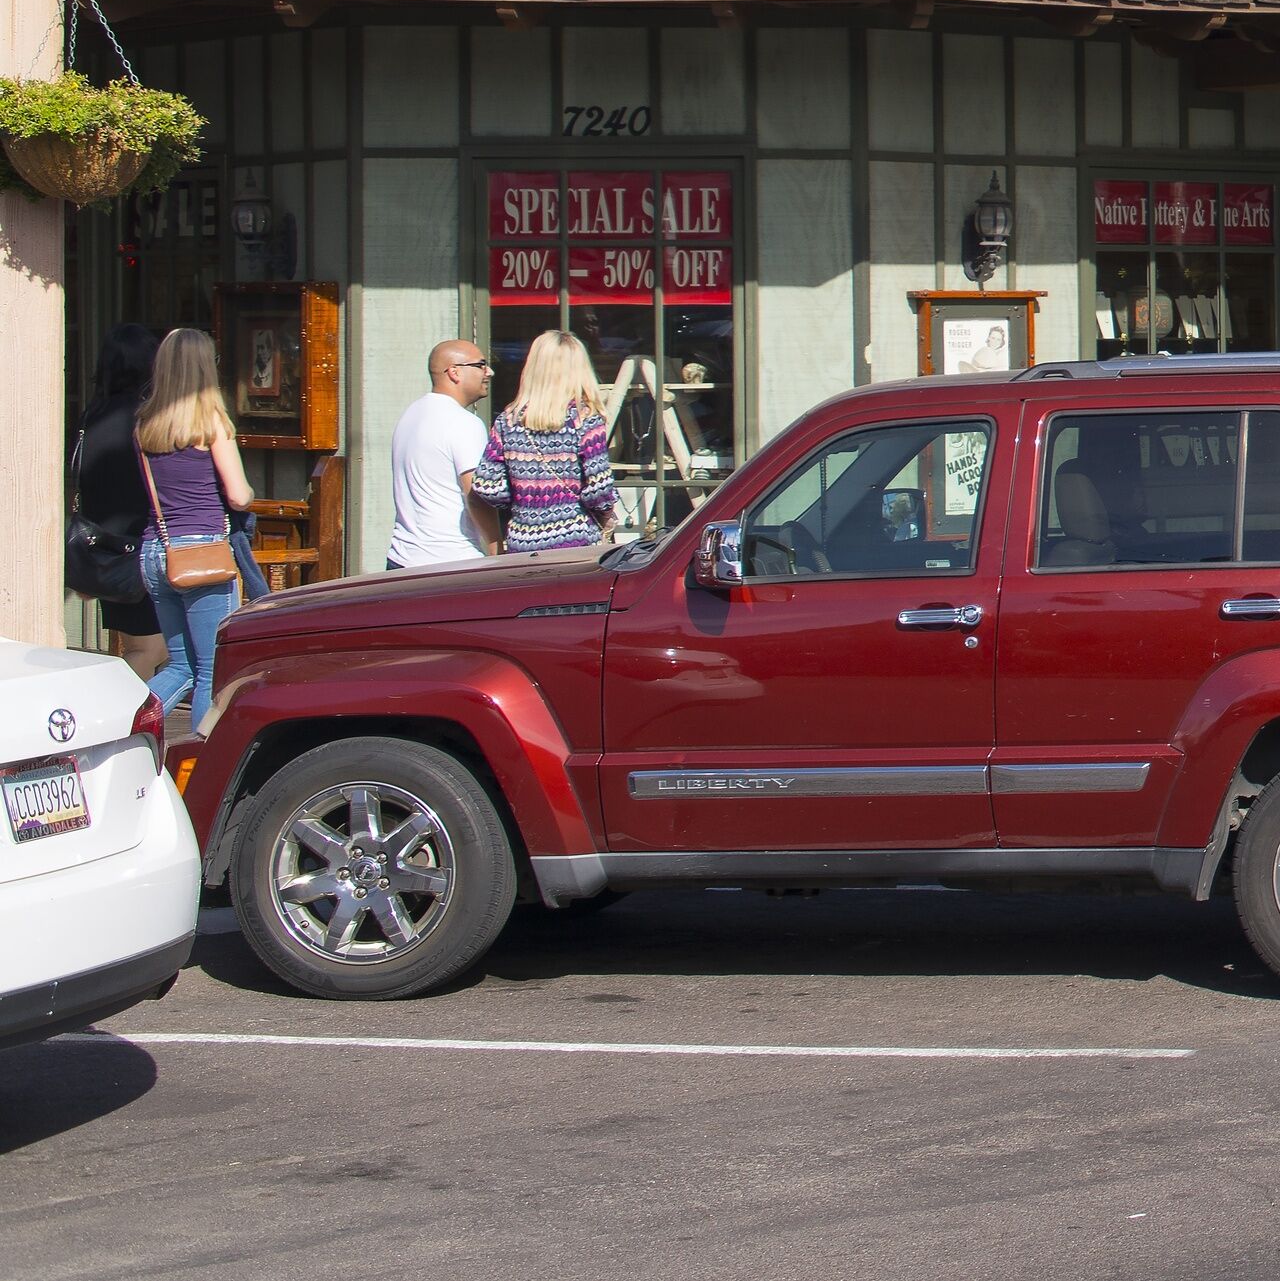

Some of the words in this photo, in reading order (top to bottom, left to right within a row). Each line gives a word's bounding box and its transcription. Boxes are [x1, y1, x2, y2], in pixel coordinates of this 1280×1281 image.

[563, 106, 650, 136] 7240
[503, 188, 634, 235] SPECIAL
[641, 187, 722, 234] SALE
[1094, 197, 1137, 226] Native
[1192, 198, 1205, 227] &
[1209, 199, 1239, 228] Fne
[1241, 201, 1271, 228] Arts
[502, 250, 554, 289] 20%
[603, 250, 655, 289] 50%
[672, 249, 724, 287] OFF
[946, 453, 978, 475] HANDS
[14, 775, 81, 820] CCD3962
[658, 778, 796, 790] LIBERTY
[31, 819, 78, 839] AVONDALE
